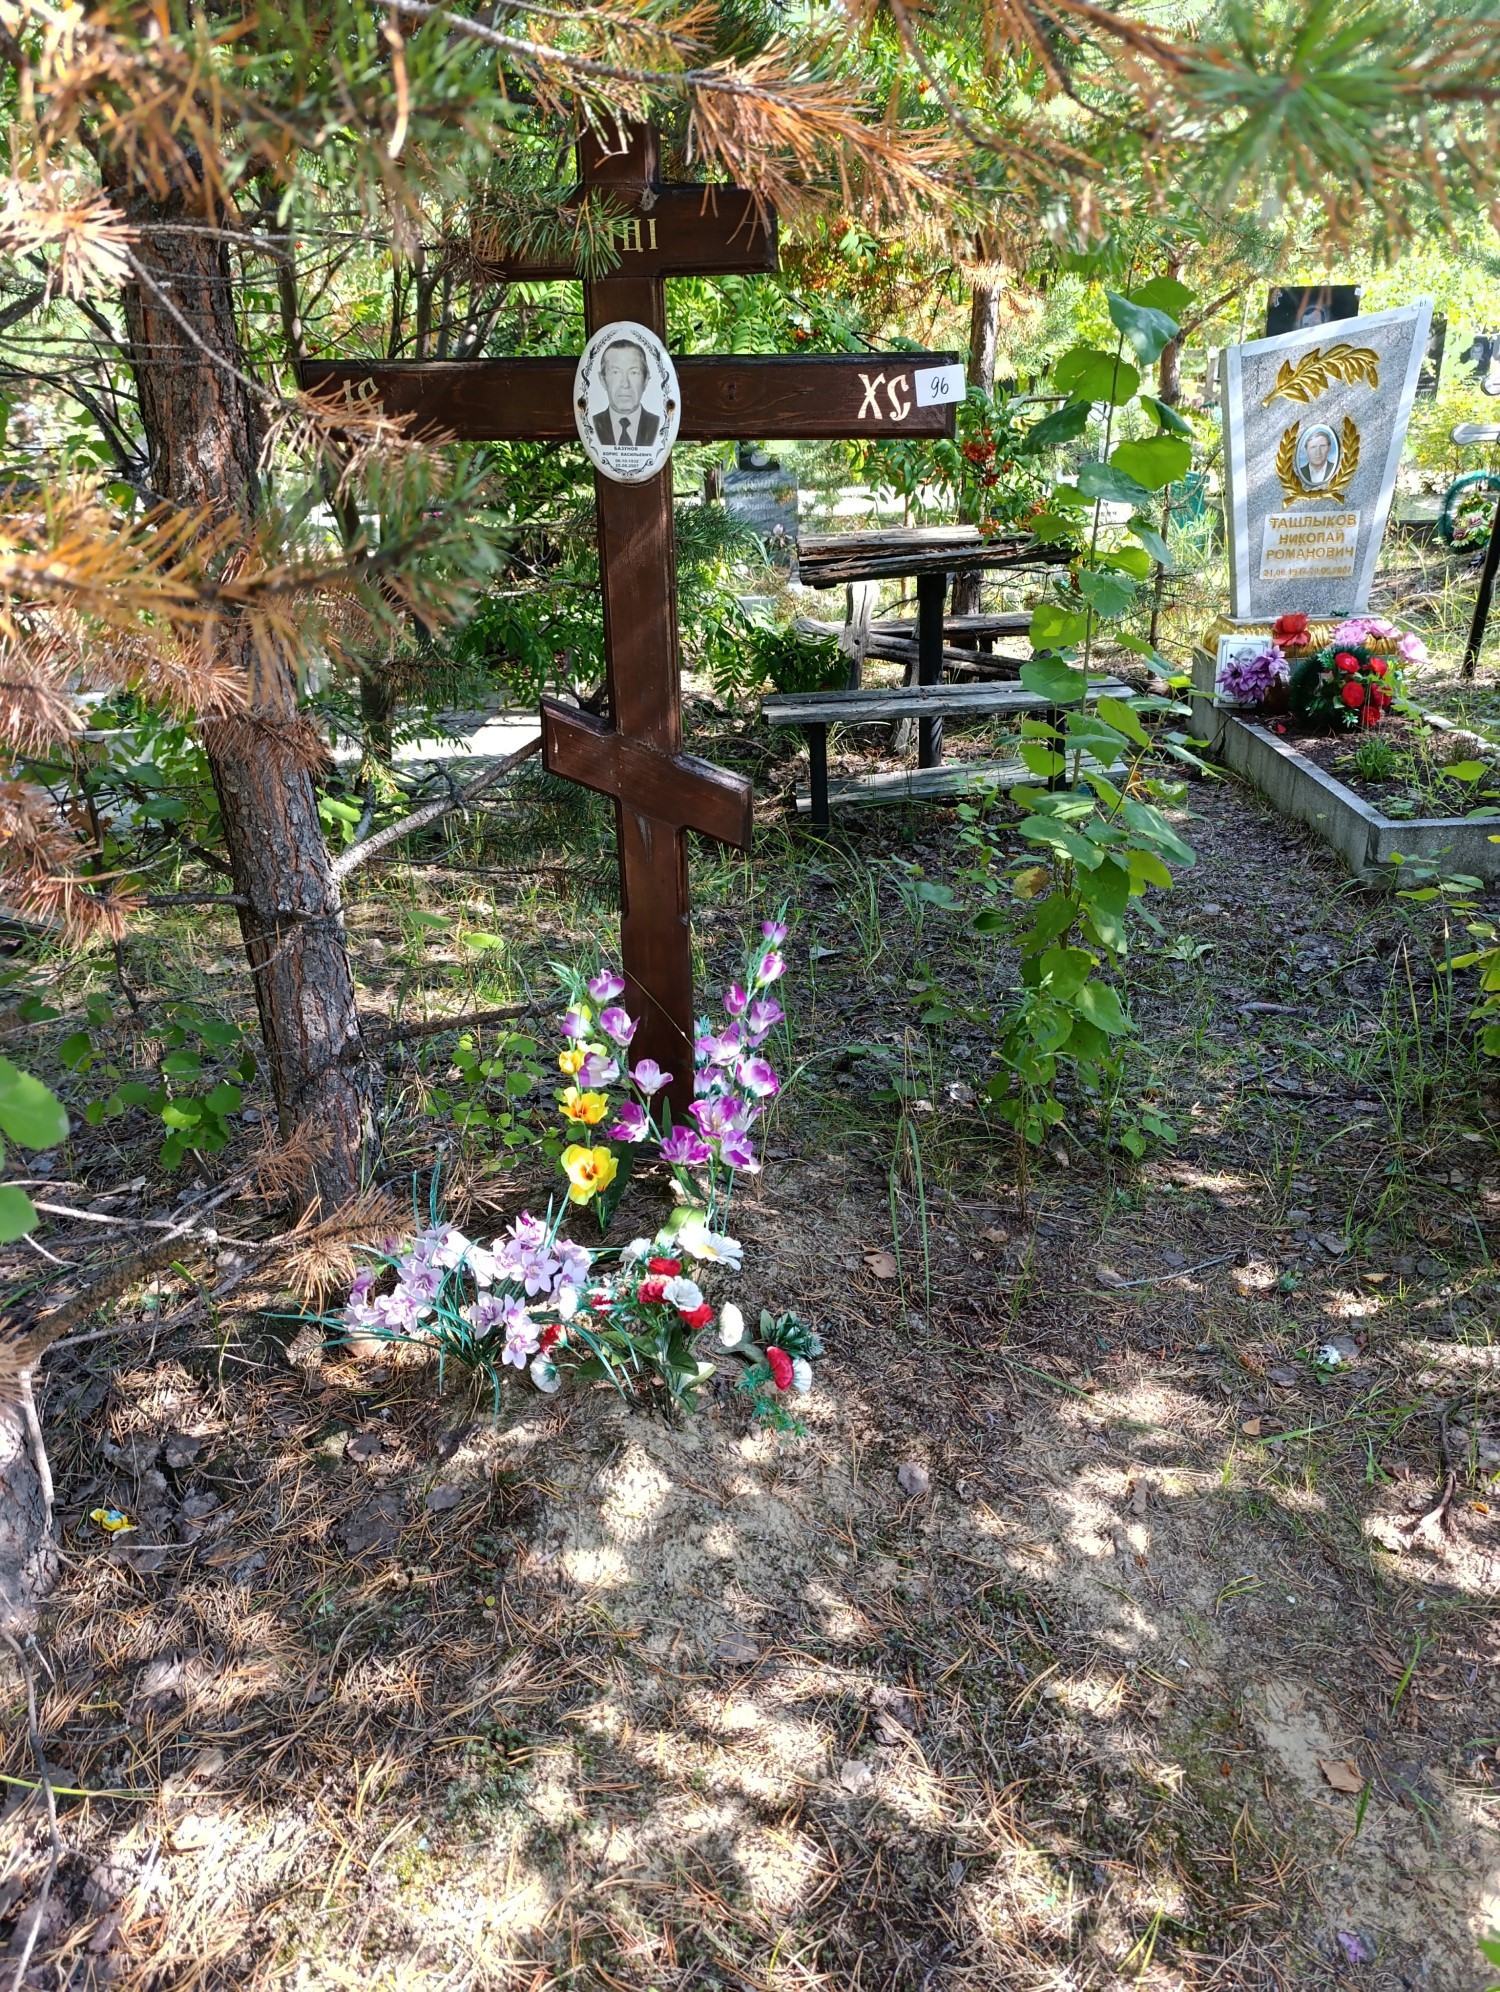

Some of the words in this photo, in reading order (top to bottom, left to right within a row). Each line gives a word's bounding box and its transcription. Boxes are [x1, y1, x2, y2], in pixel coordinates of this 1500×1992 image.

[930, 376, 949, 398] 96
[1269, 514, 1357, 529] ТАШЛЫКОВ
[1279, 530, 1345, 545] НИКОЛАЙ
[1266, 546, 1354, 560] РОМАНОВИЧ
